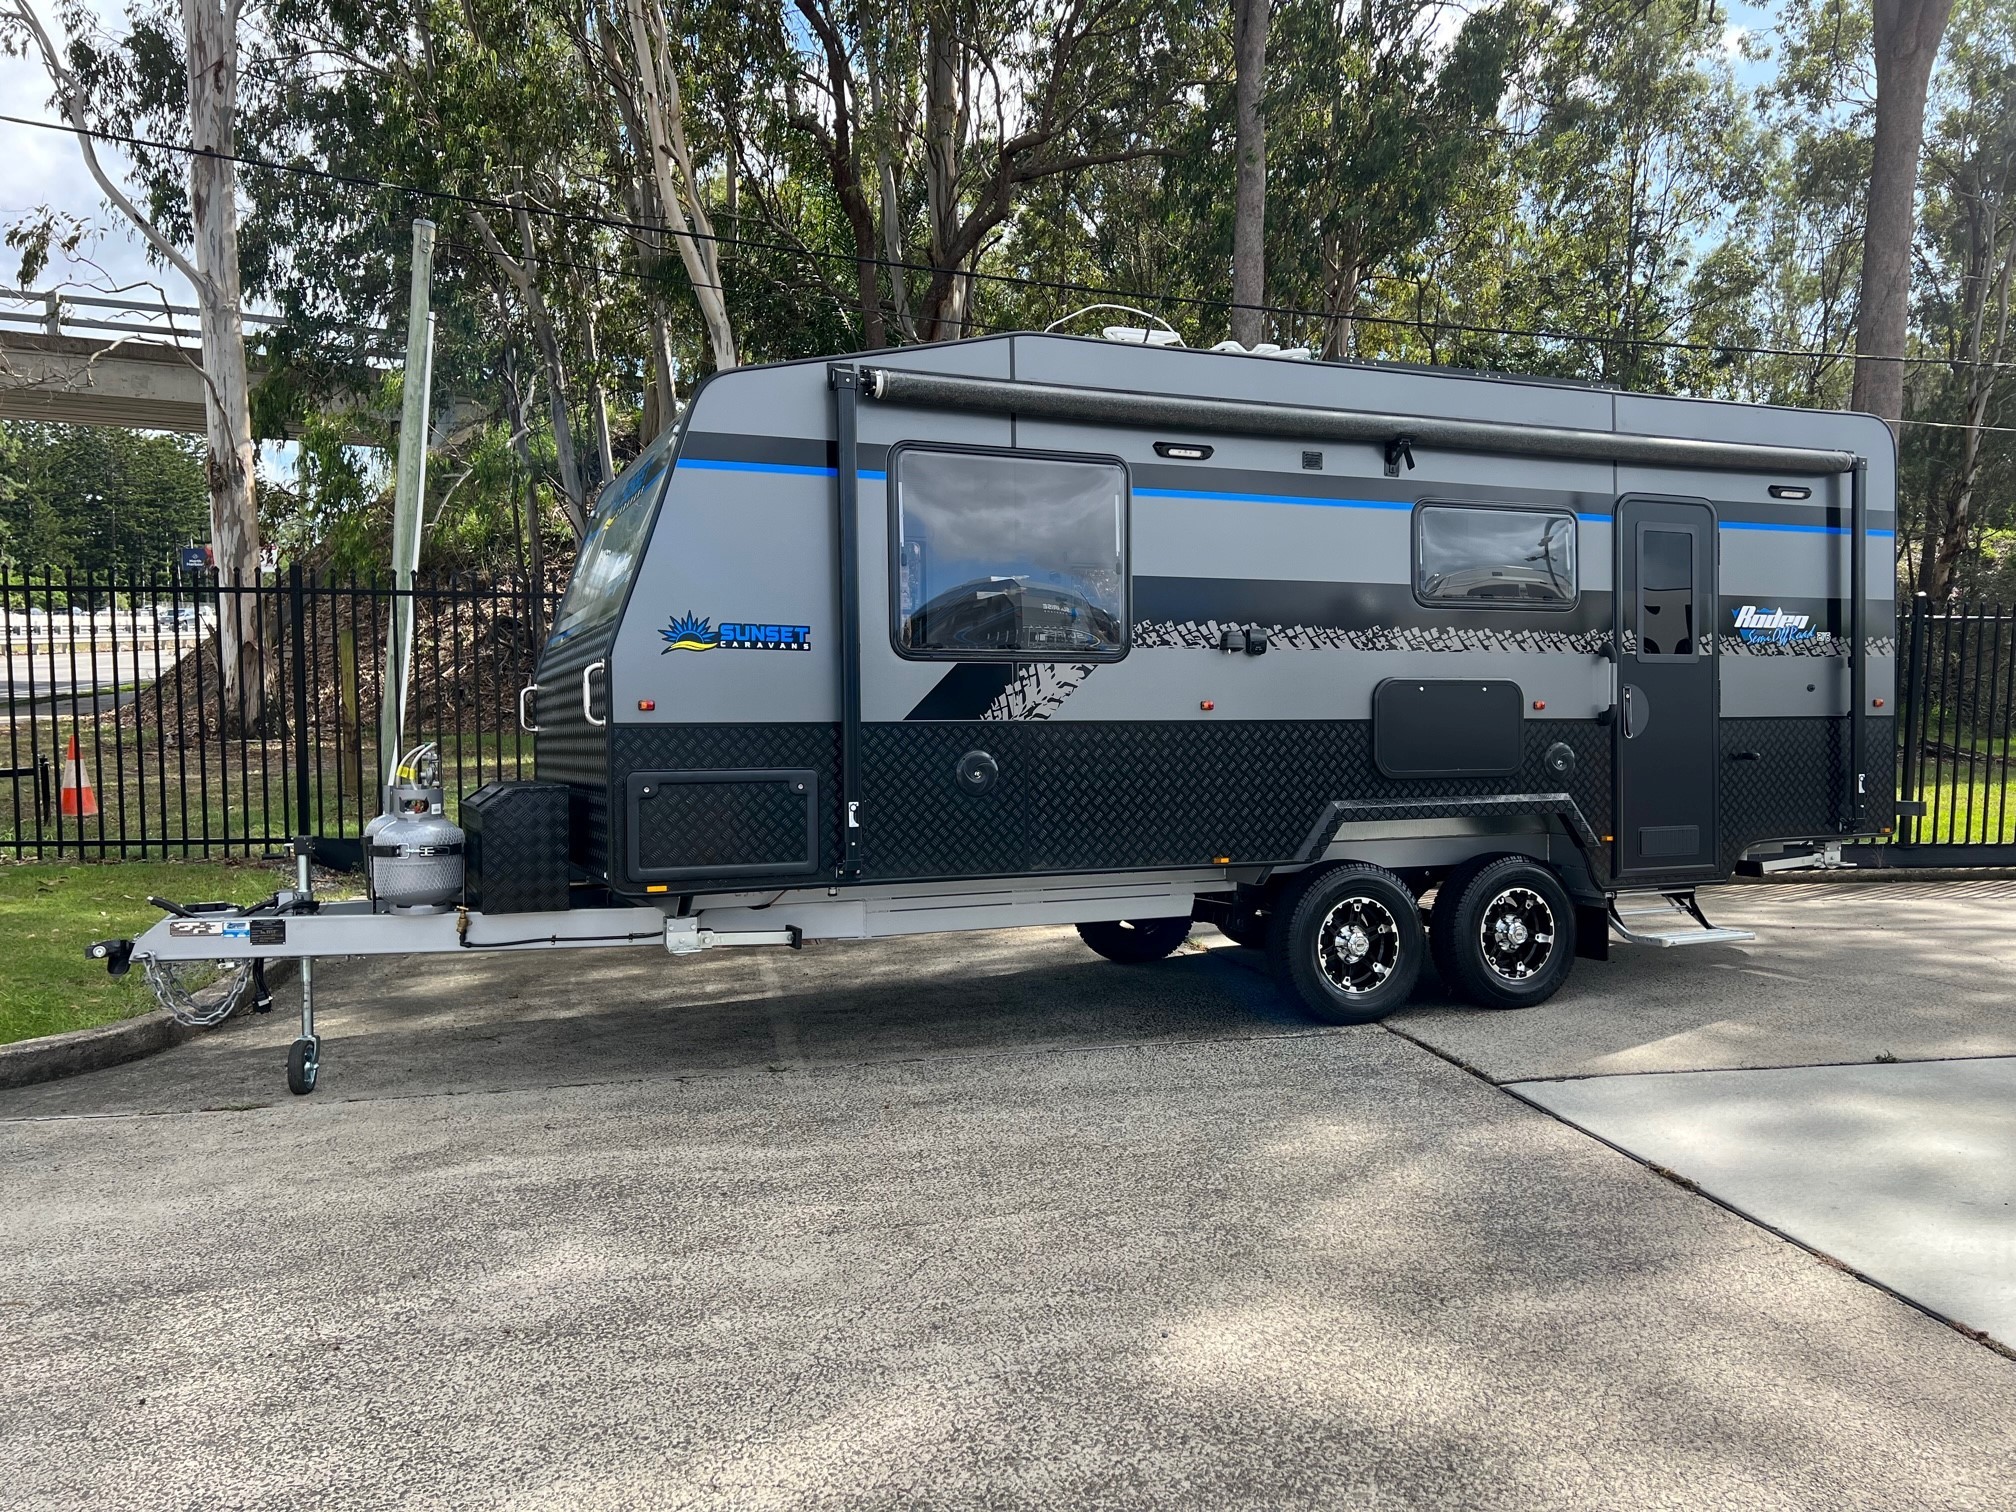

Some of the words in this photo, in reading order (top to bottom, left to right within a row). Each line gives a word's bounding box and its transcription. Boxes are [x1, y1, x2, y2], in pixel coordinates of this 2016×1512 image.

[1734, 605, 1810, 629] Rodeo
[719, 624, 810, 643] SUNSET
[720, 641, 809, 650] CARAVANS
